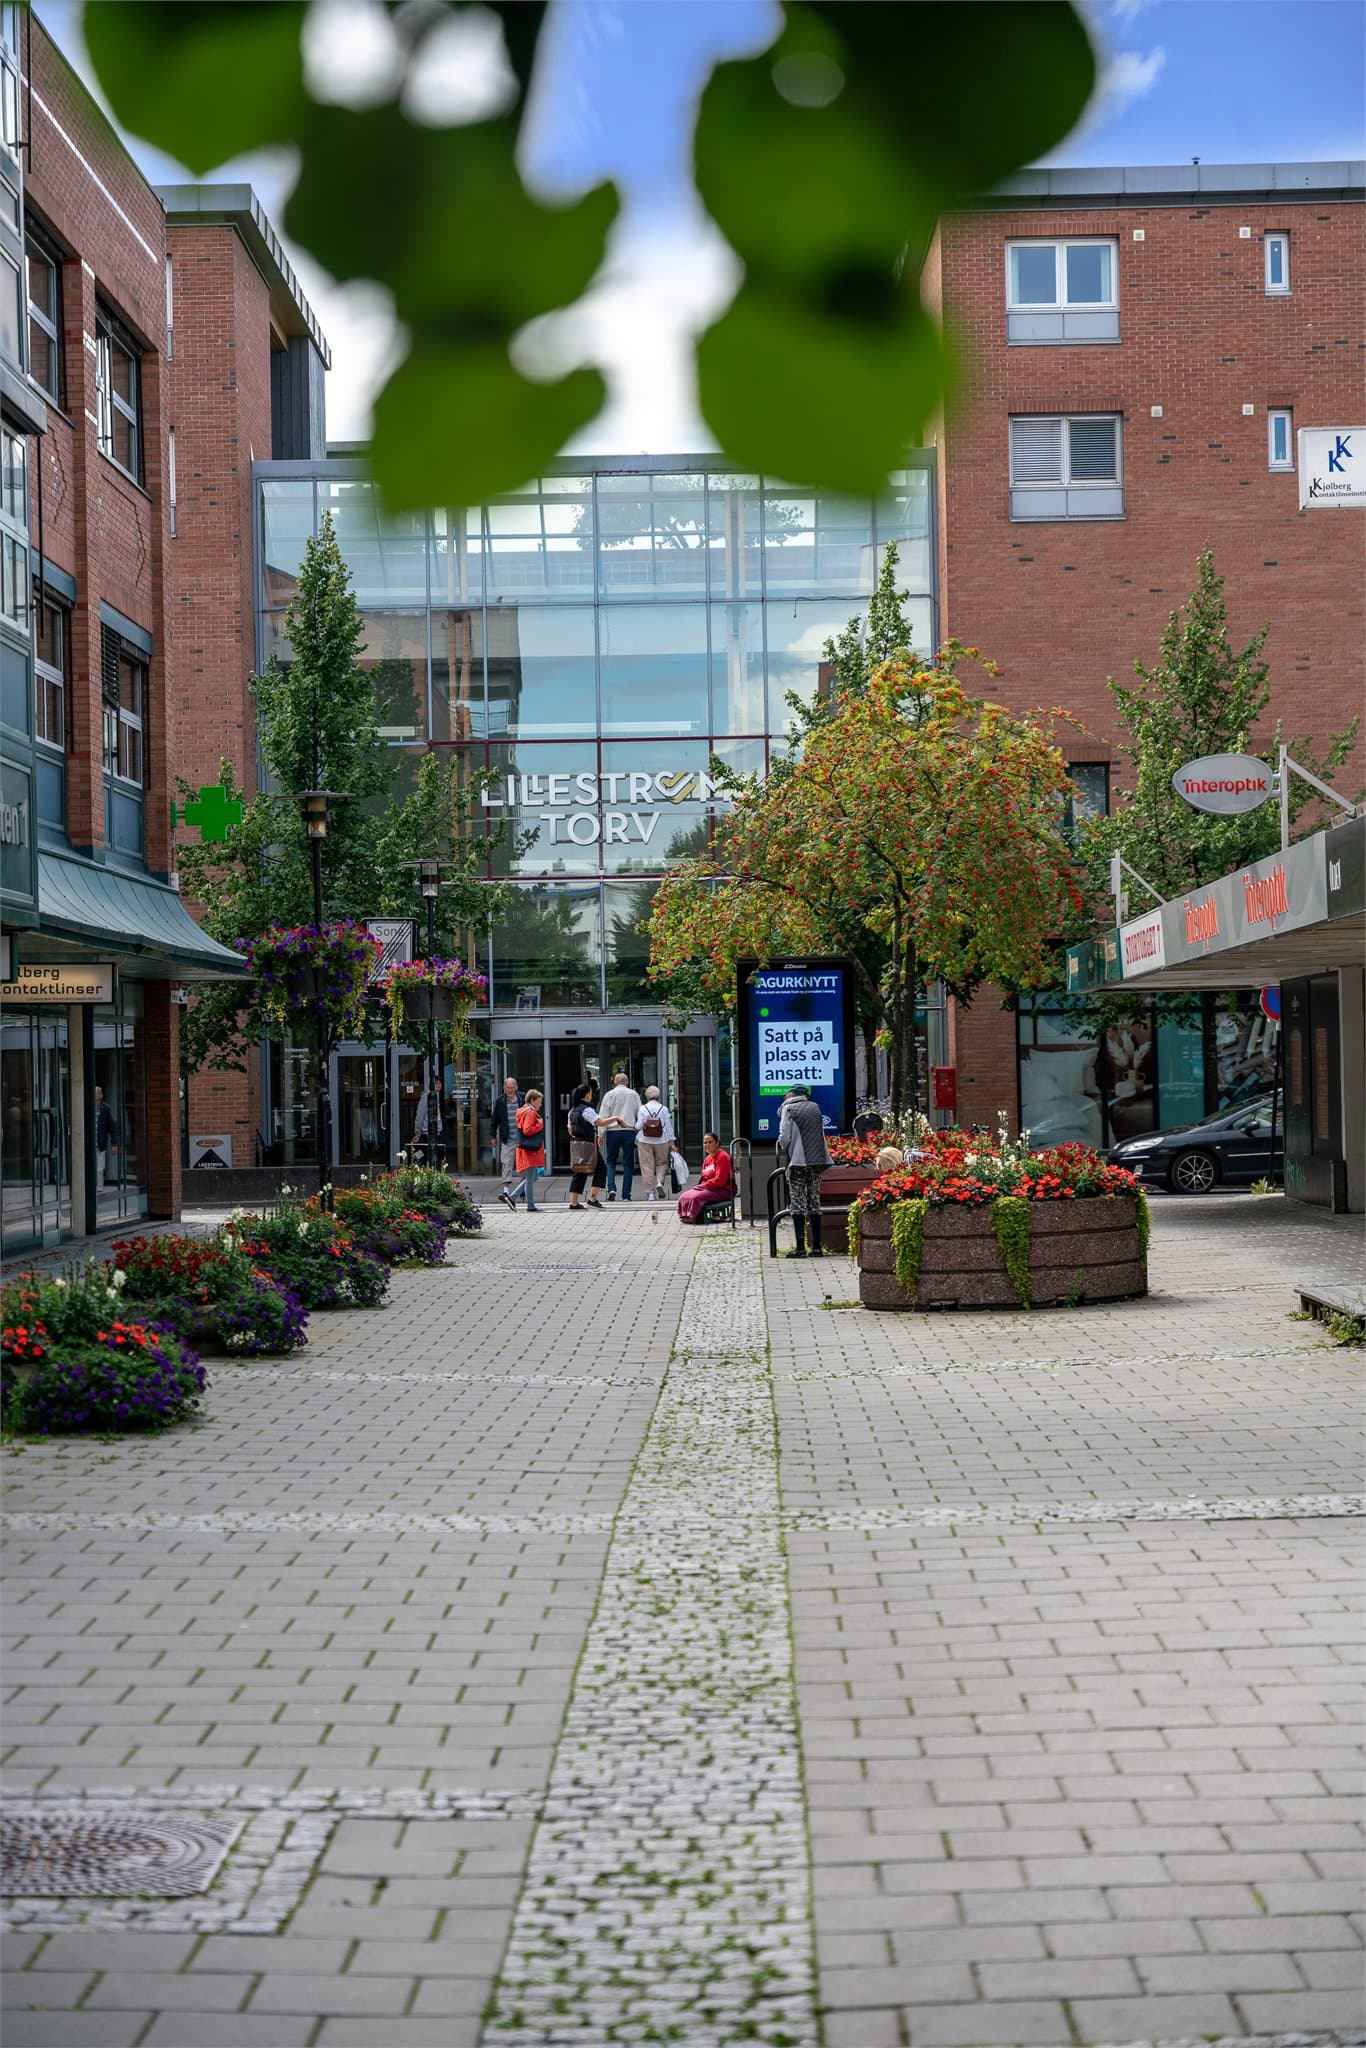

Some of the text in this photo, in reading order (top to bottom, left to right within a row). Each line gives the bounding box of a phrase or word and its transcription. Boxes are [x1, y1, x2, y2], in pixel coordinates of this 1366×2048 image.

[1313, 477, 1352, 491] Kjølberg
[1182, 777, 1267, 795] interoptik
[540, 811, 661, 846] TORV
[757, 976, 838, 988] AGURKNYTT
[764, 1026, 823, 1045] Satt på
[765, 1046, 831, 1064] plass av
[765, 1066, 822, 1080] ansatt:
